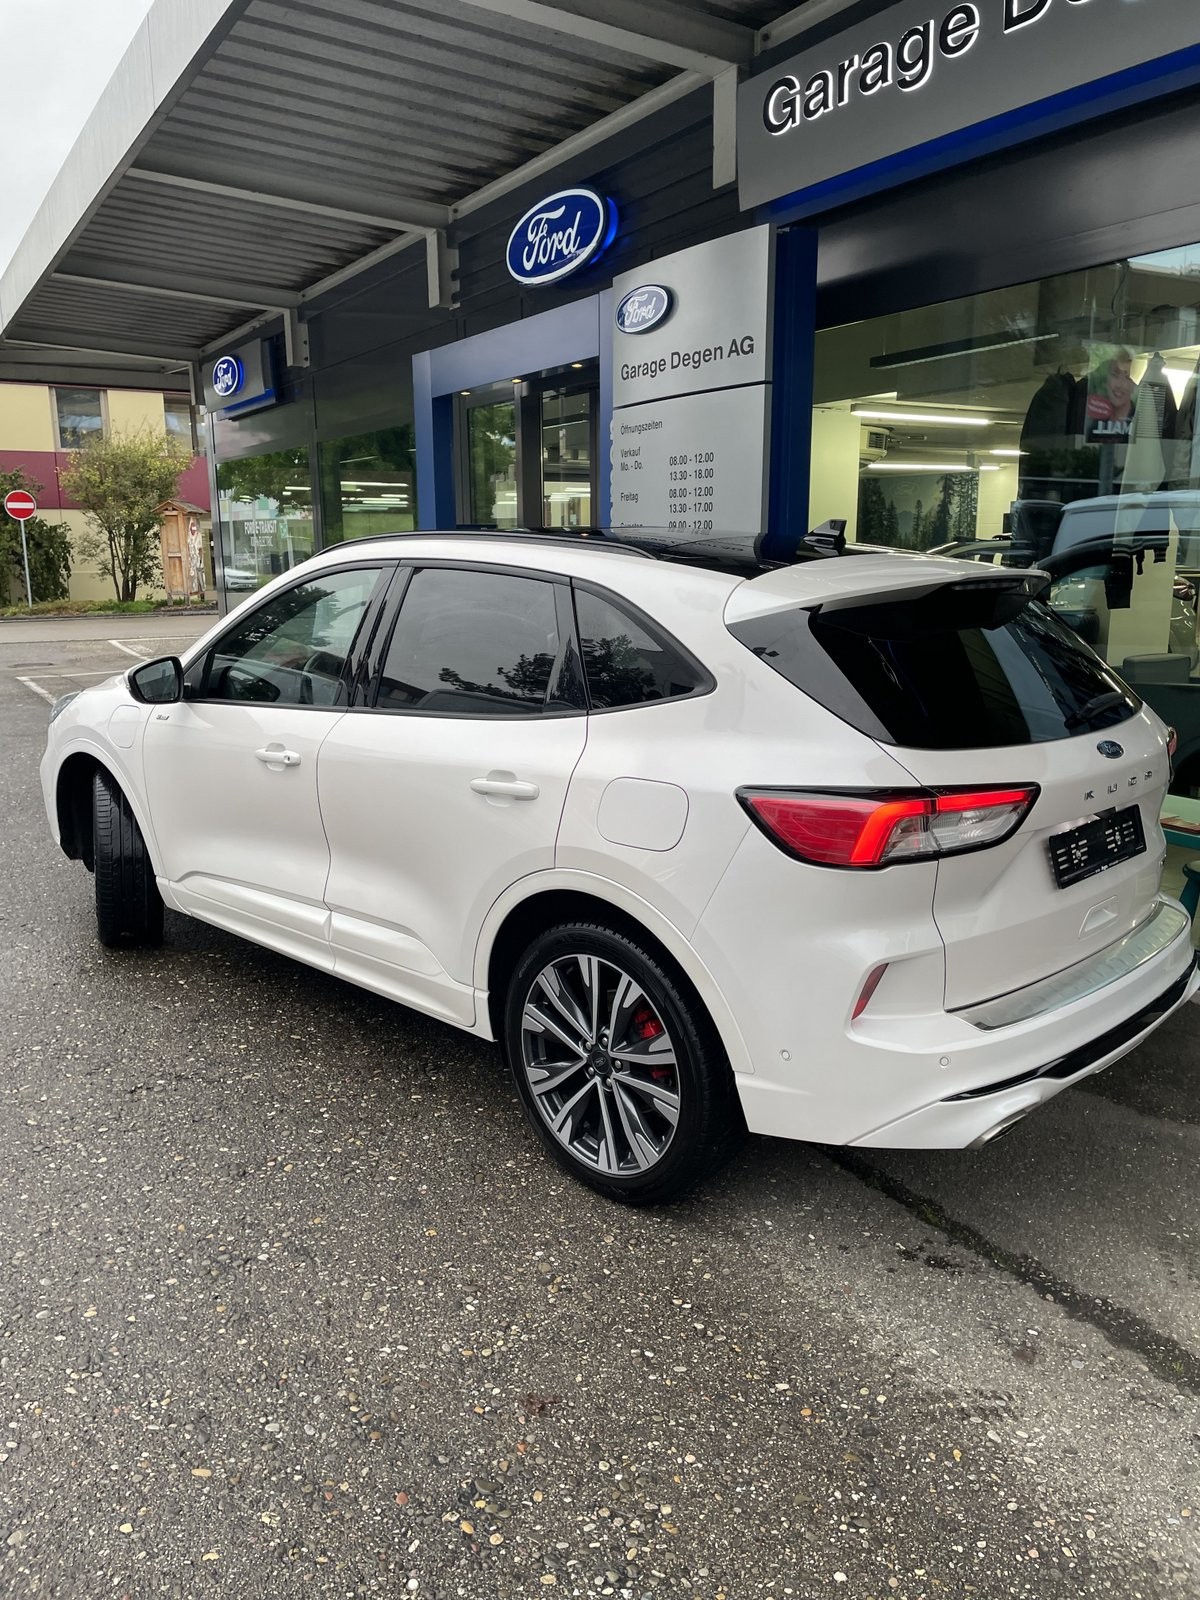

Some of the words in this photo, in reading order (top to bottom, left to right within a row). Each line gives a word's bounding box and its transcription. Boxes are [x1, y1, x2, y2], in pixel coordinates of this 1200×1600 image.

[763, 3, 980, 136] Garage
[522, 204, 582, 271] Ford
[624, 293, 657, 325] Ford
[620, 358, 667, 381] Garage
[670, 345, 724, 370] Degen
[727, 335, 755, 358] AG
[217, 362, 233, 390] Ford
[619, 420, 663, 435] Öffnungszeiten
[620, 446, 641, 458] Verkauf
[634, 460, 644, 470] Do.
[669, 454, 688, 466] 08.00
[694, 452, 715, 464] 12.00
[669, 470, 688, 481] 13.30
[694, 468, 714, 479] 18.00
[620, 492, 639, 503] Freitag
[668, 488, 687, 499] 08.00
[693, 486, 714, 497] 12.00
[669, 503, 687, 513] 13.30
[693, 501, 713, 512] 17.00
